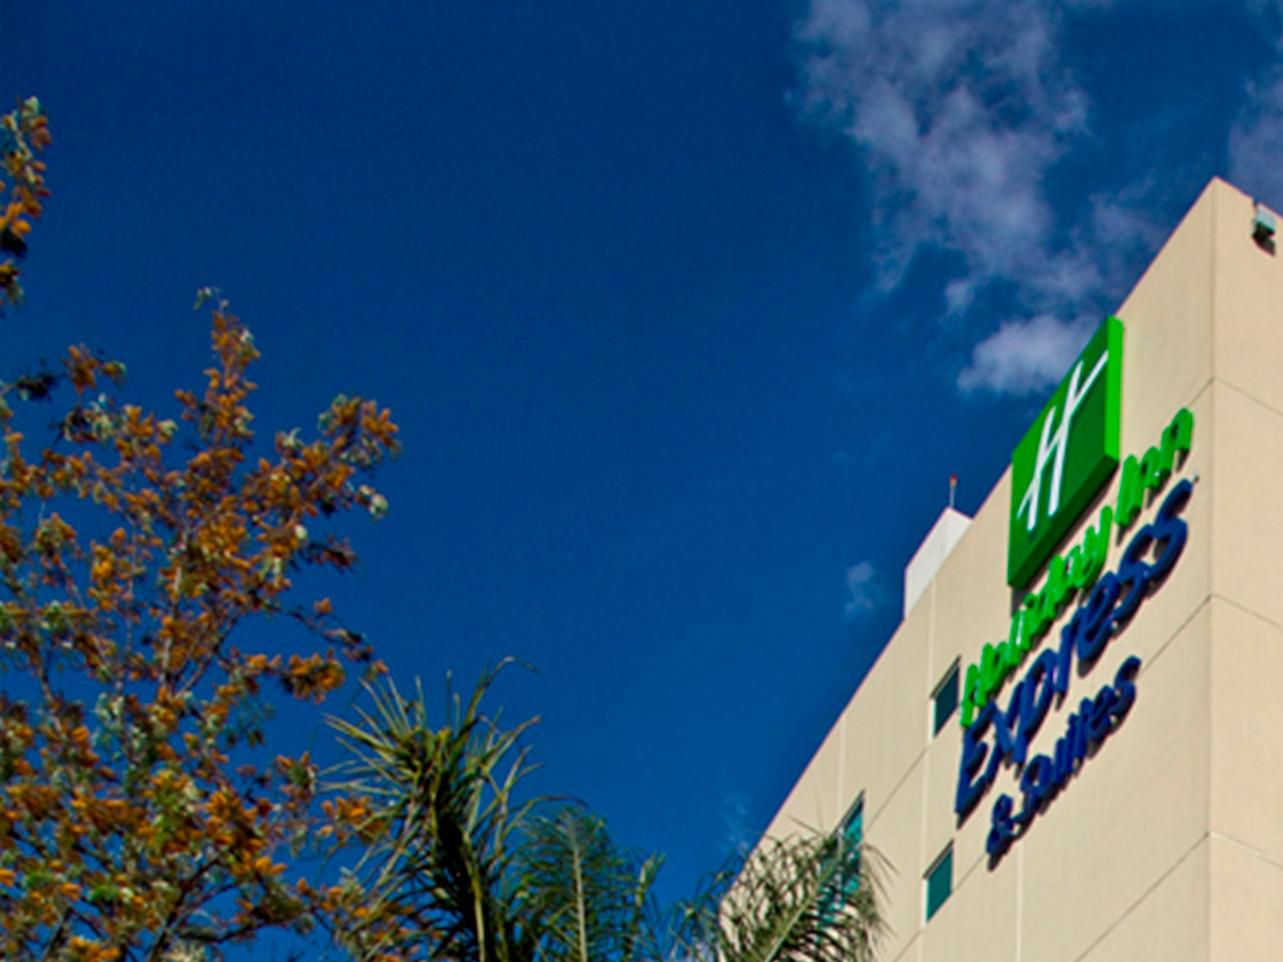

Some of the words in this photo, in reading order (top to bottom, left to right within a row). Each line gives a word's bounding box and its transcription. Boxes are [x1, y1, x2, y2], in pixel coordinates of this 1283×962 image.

[954, 478, 1194, 826] Express
[960, 504, 1113, 728] Holiday
[1115, 408, 1194, 530] Inn
[986, 793, 1015, 860] &
[1012, 655, 1142, 838] Suites
